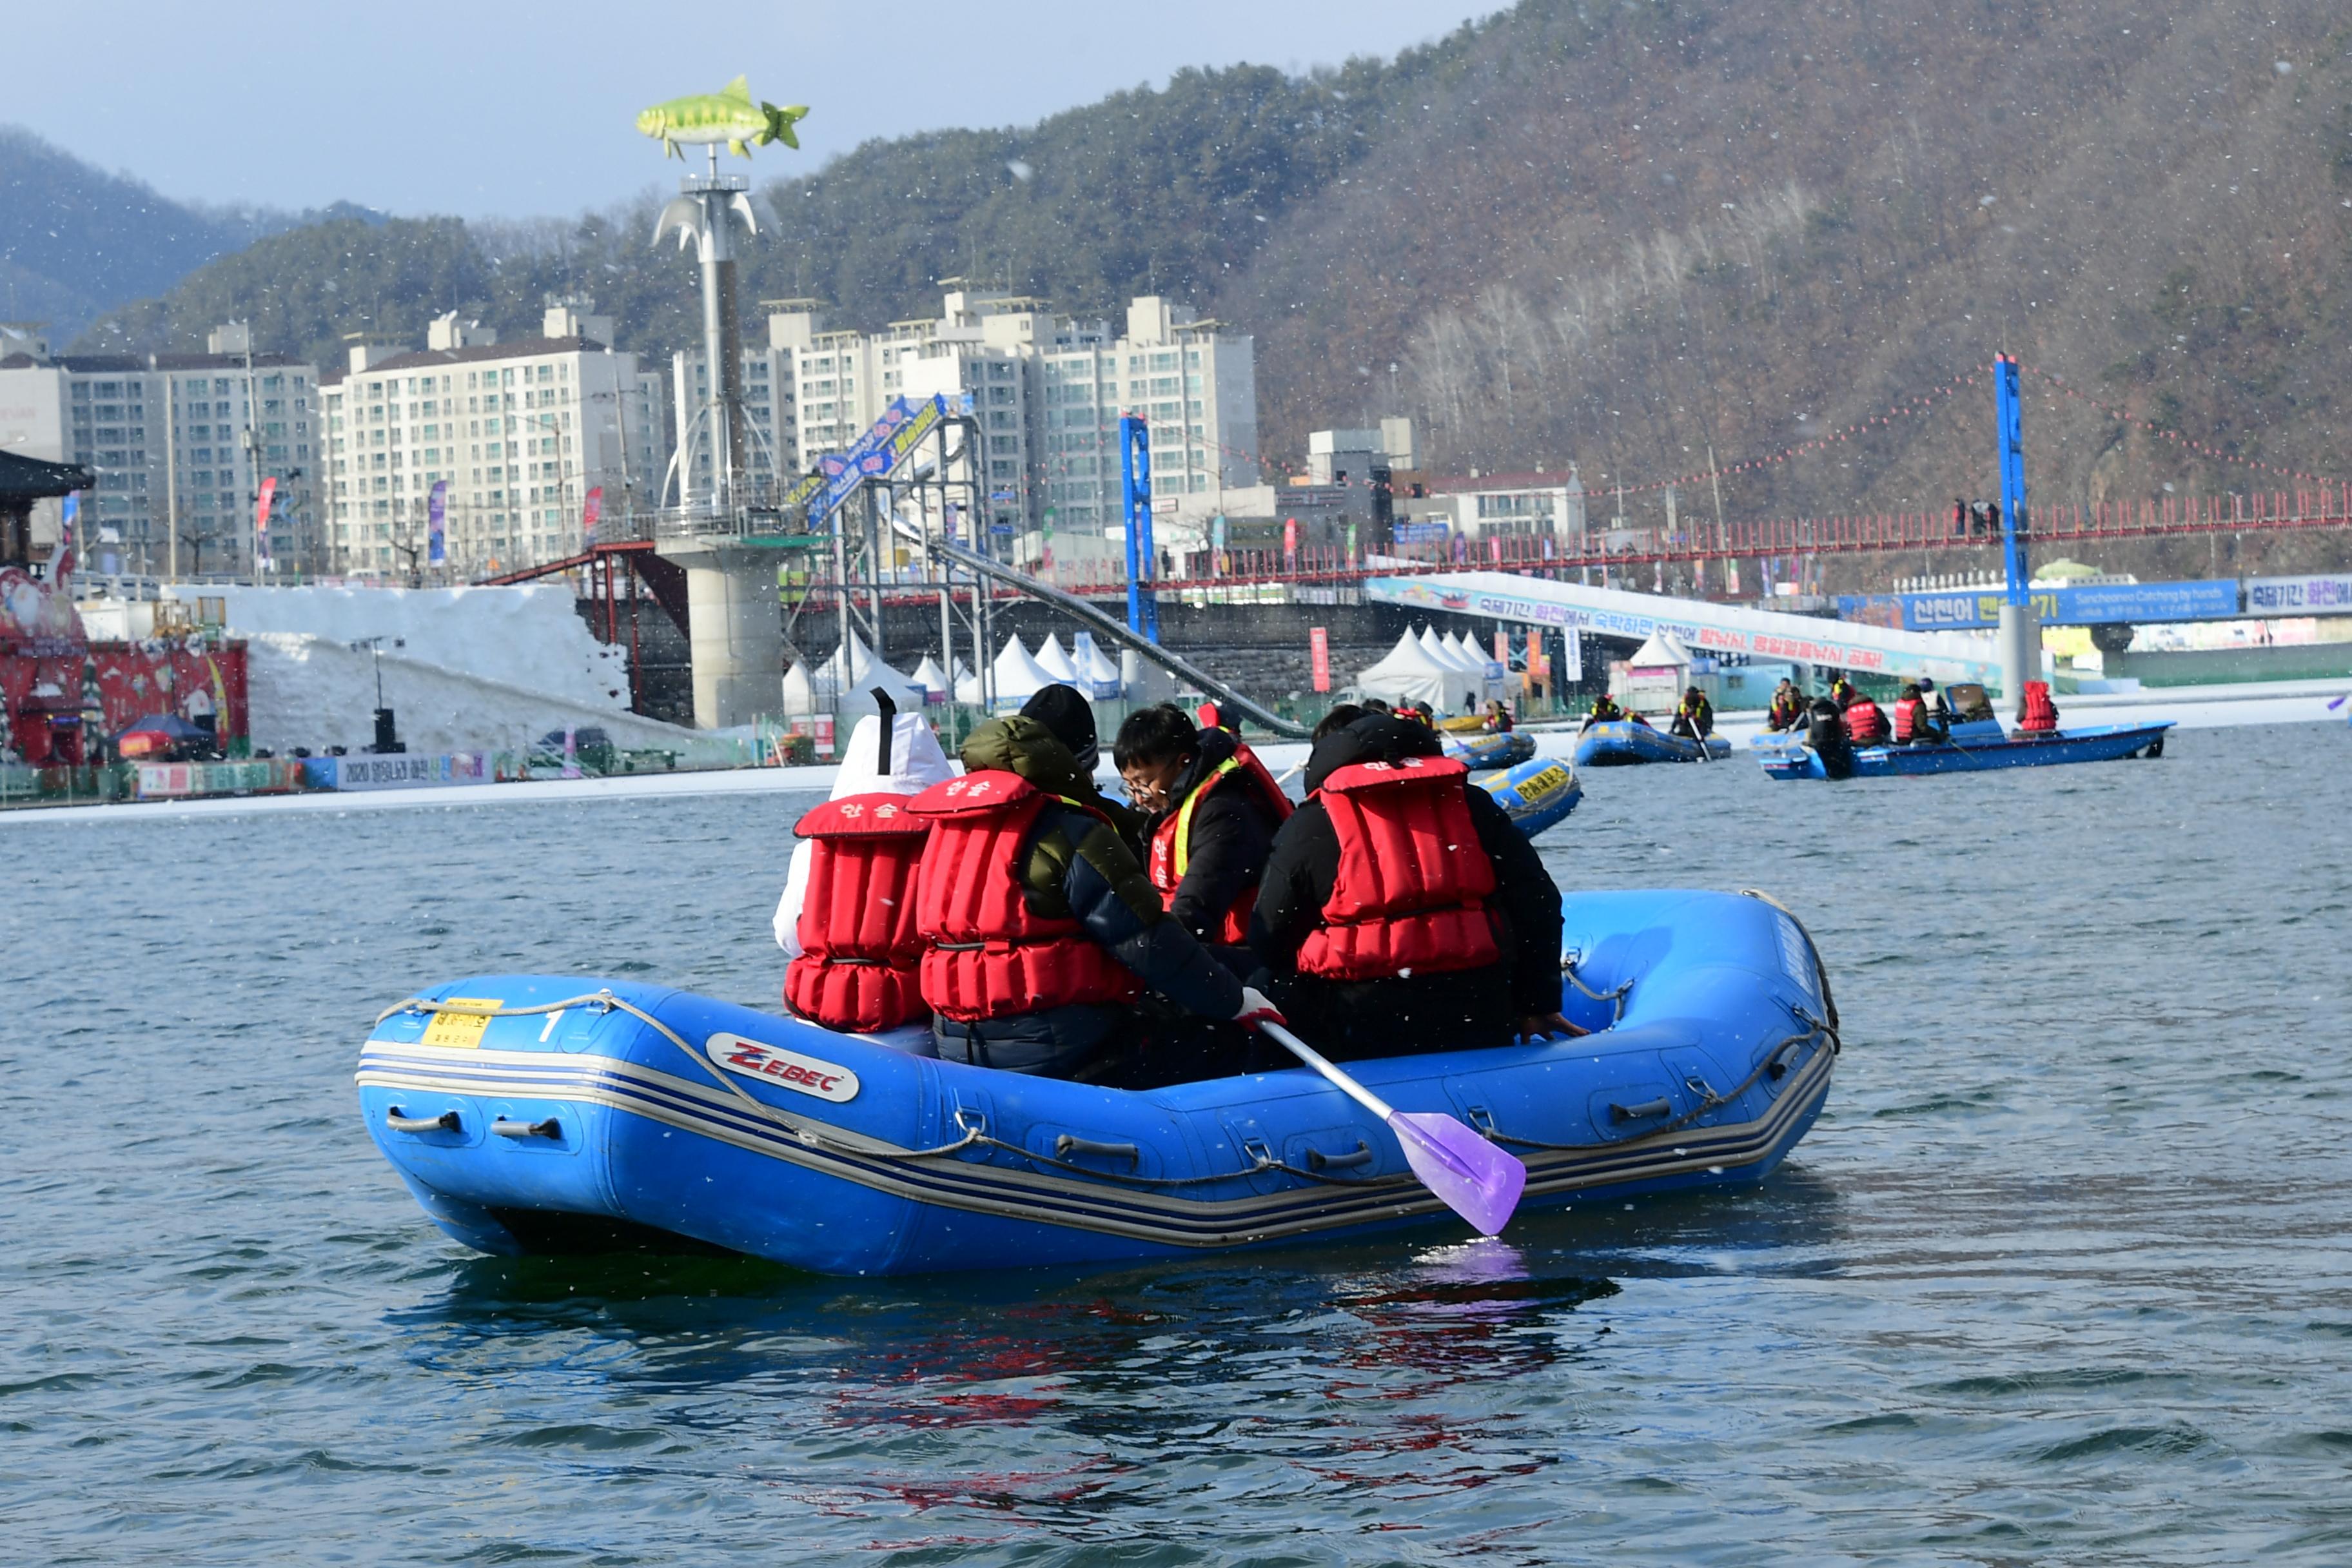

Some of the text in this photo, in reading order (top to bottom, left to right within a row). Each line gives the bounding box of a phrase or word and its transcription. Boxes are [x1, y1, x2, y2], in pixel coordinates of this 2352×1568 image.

[1914, 597, 1974, 624] 산천어
[1978, 593, 2058, 621] 맨기
[2253, 580, 2352, 607] 축제기간 화천에
[1479, 597, 1531, 618] 축제기간
[1534, 603, 1591, 625] 화천에서
[1594, 610, 1654, 636] 숙박하면
[346, 761, 369, 783] 2020
[538, 1009, 566, 1043] 1
[723, 1041, 843, 1092] ZEBEC
